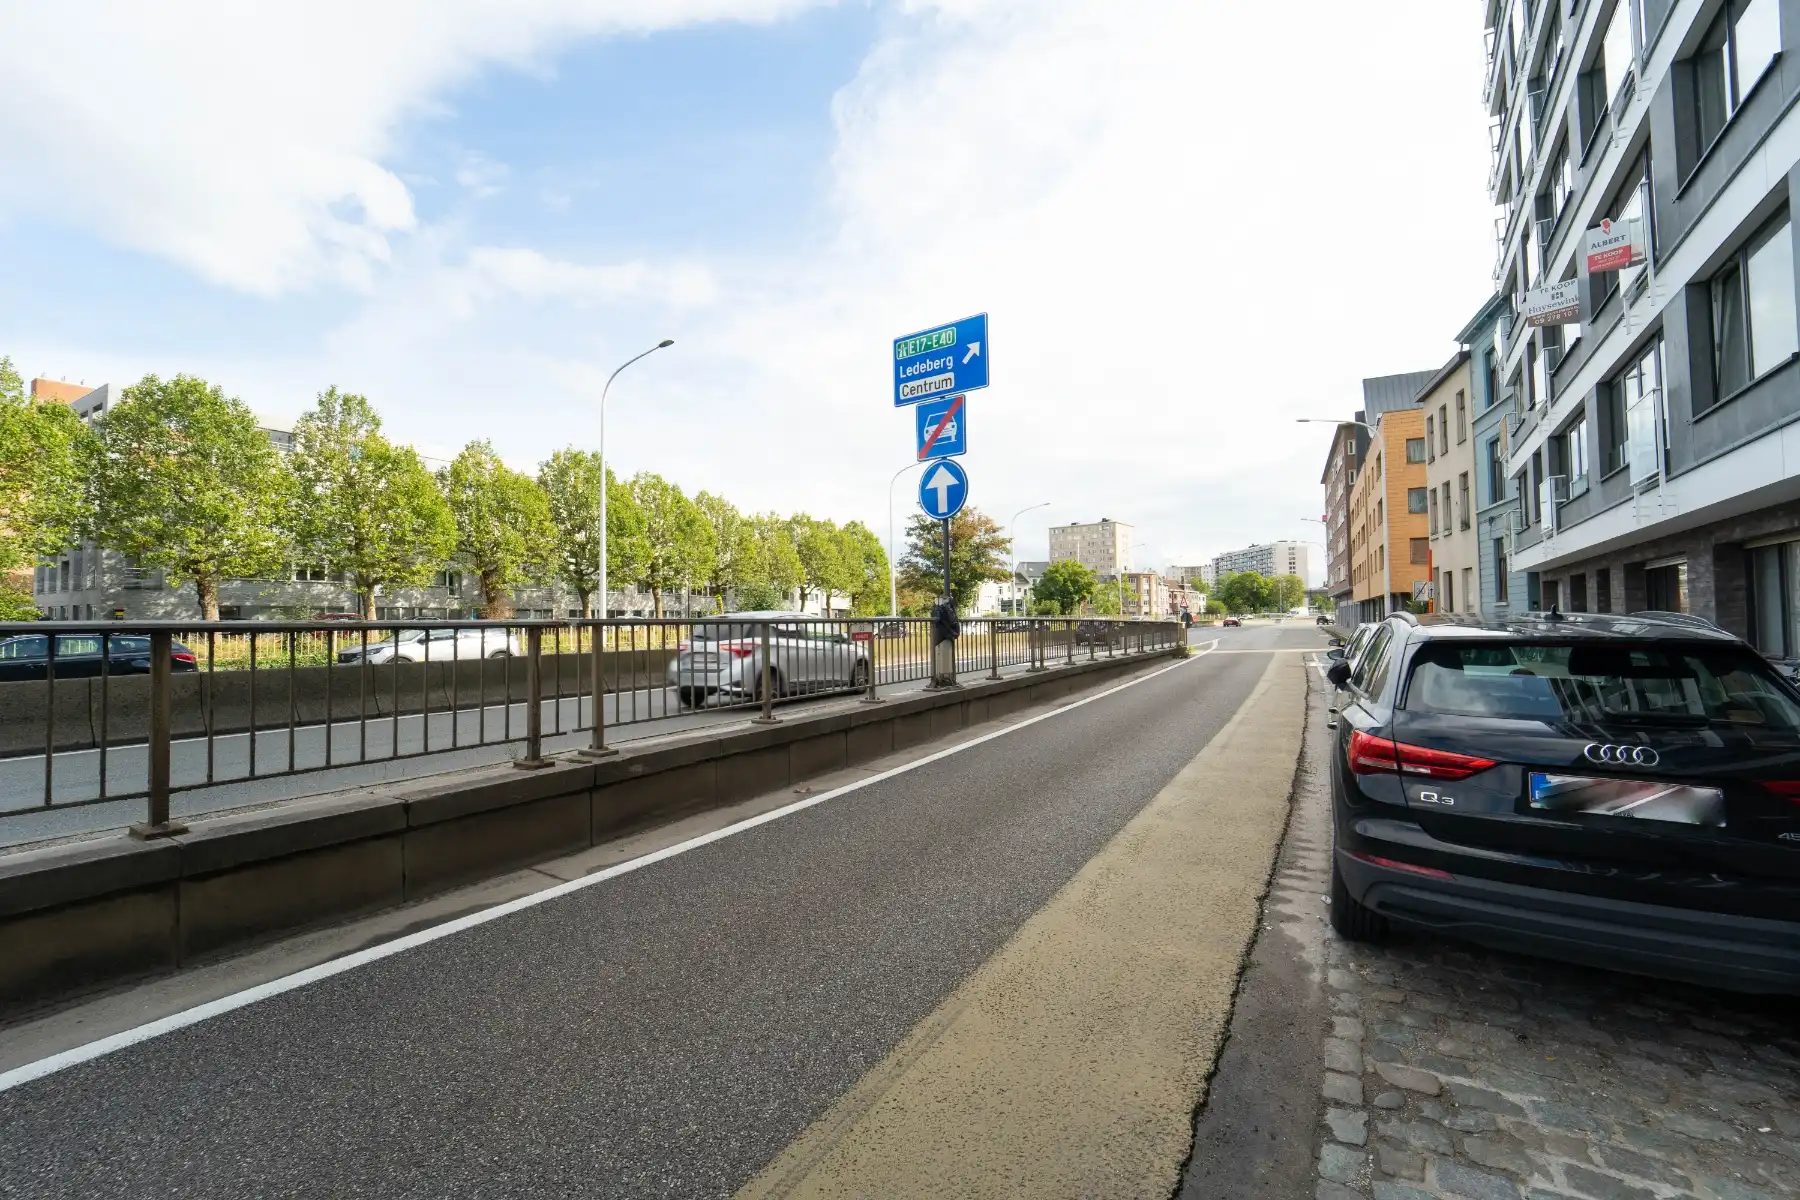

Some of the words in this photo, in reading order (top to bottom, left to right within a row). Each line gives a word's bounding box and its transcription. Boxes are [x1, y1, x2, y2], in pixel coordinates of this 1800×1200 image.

[1591, 234, 1626, 249] ALBERT
[1603, 249, 1624, 259] KOOP
[1551, 280, 1576, 291] KOOP
[1534, 317, 1545, 325] 09
[1563, 310, 1573, 318] 10
[900, 356, 954, 378] Ledeberg
[902, 377, 953, 397] Centrum
[1420, 791, 1455, 805] Q3
